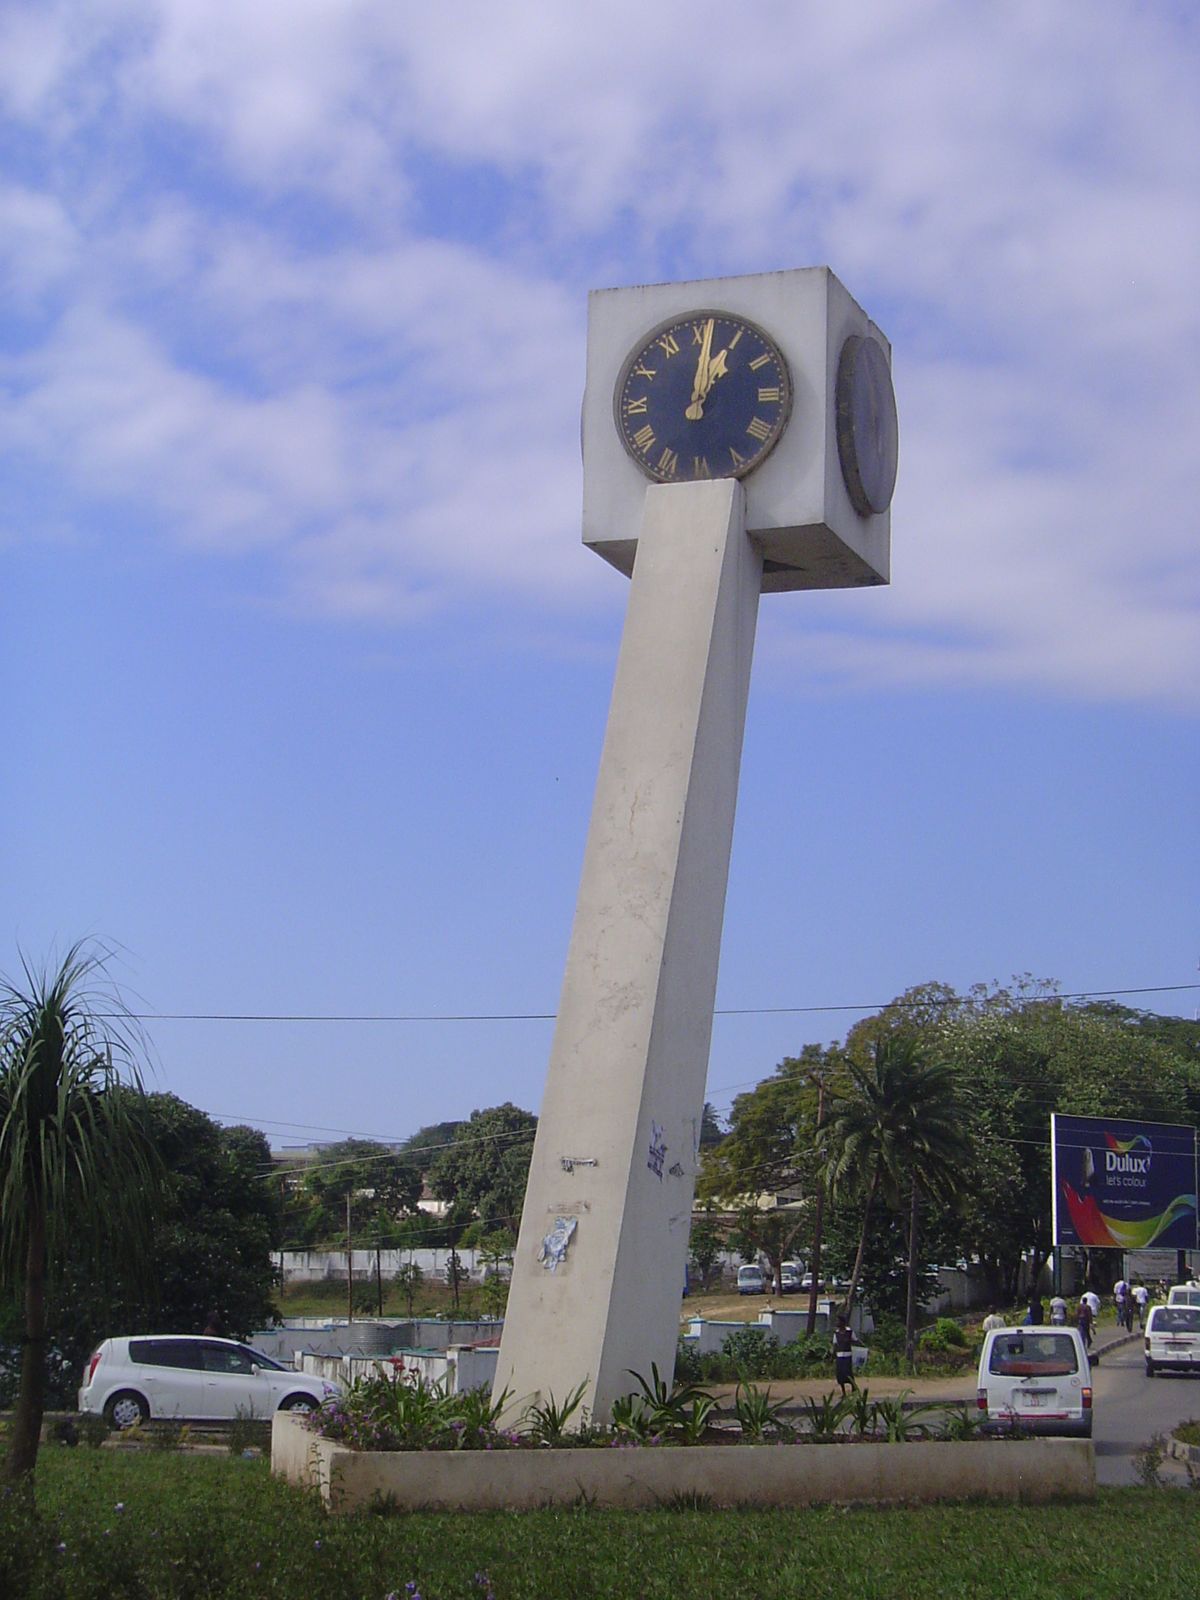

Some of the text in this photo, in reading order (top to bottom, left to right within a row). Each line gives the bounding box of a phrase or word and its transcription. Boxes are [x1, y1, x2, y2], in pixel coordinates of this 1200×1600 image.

[659, 334, 680, 359] XI
[749, 353, 771, 371] II
[636, 364, 656, 381] X
[758, 387, 780, 402] III
[627, 396, 648, 414] IX
[633, 424, 657, 454] VIII
[657, 447, 679, 474] VII
[1105, 1151, 1147, 1173] Dulux
[1123, 1176, 1147, 1188] colour
